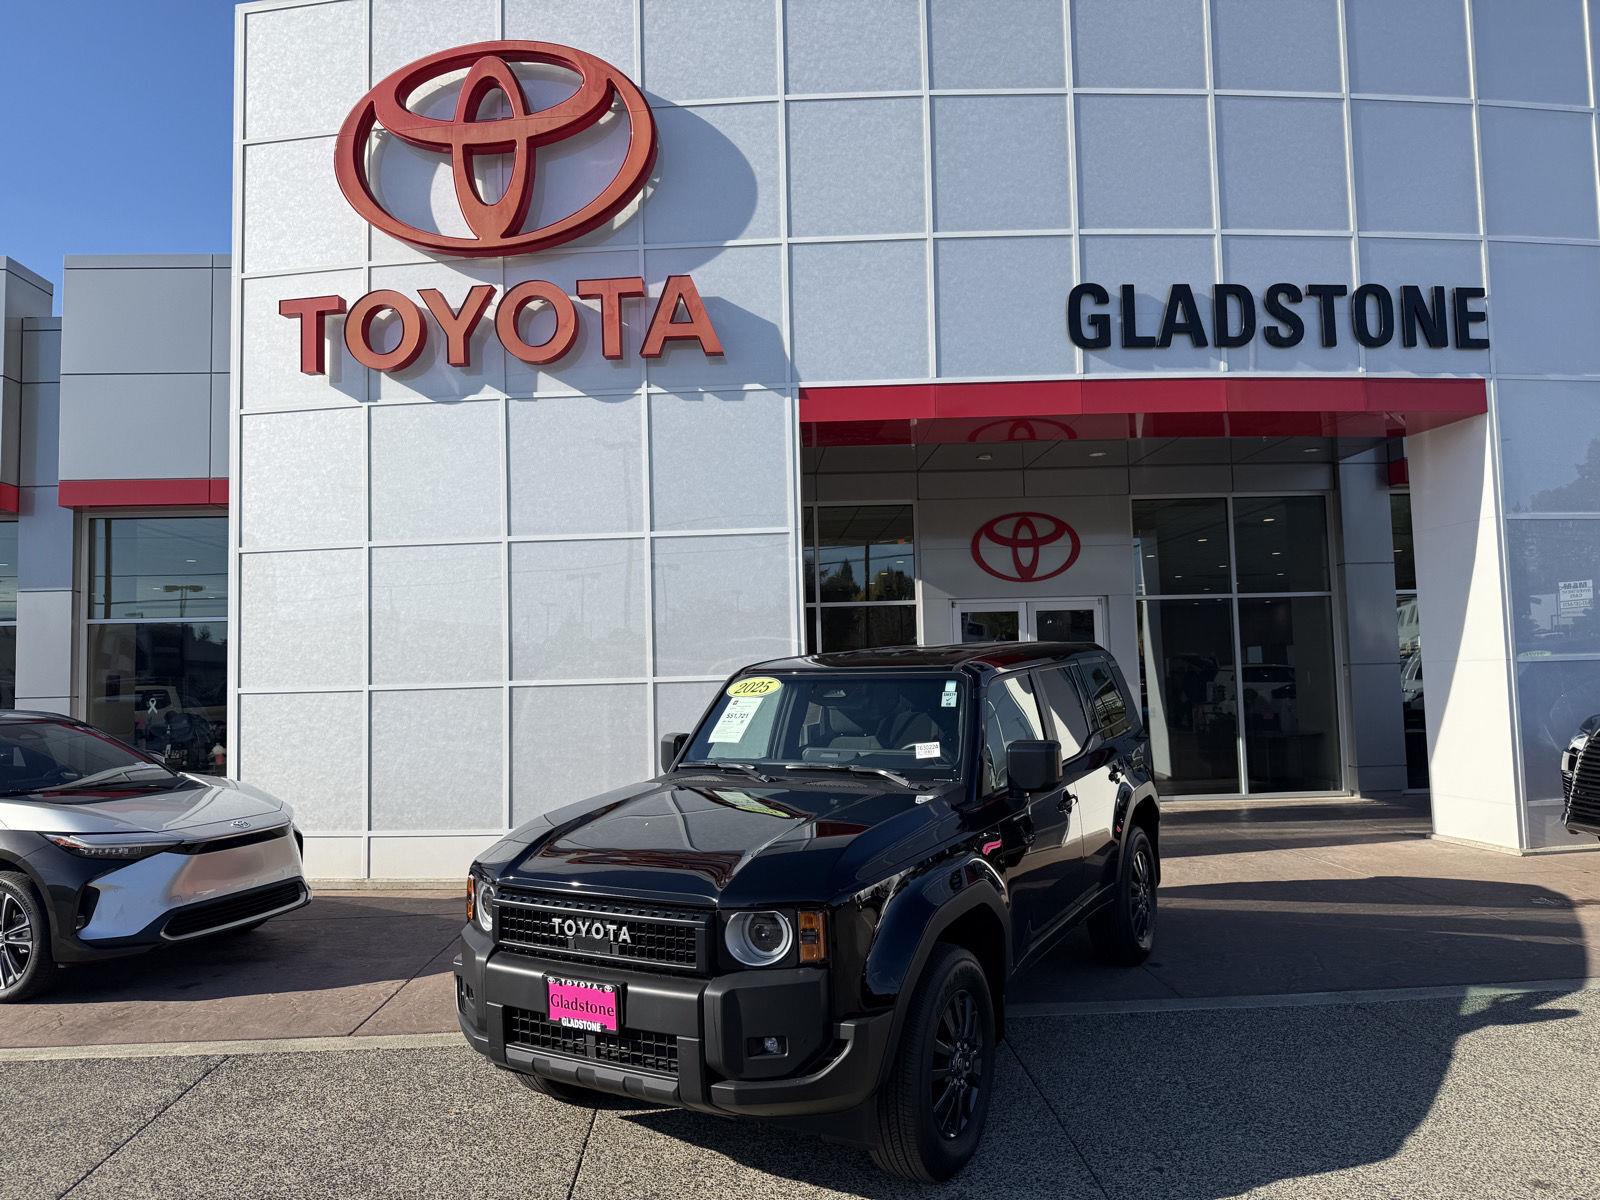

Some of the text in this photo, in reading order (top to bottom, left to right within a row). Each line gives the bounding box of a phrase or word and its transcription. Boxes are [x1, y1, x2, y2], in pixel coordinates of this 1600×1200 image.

[278, 274, 725, 375] TOYOTA
[1066, 282, 1490, 349] GLADSTONE
[734, 682, 774, 694] 2025
[552, 918, 631, 943] TOYOTA
[561, 978, 598, 990] TOYOTA
[551, 994, 614, 1016] Gladstone
[562, 1018, 601, 1032] GLADSTONE
